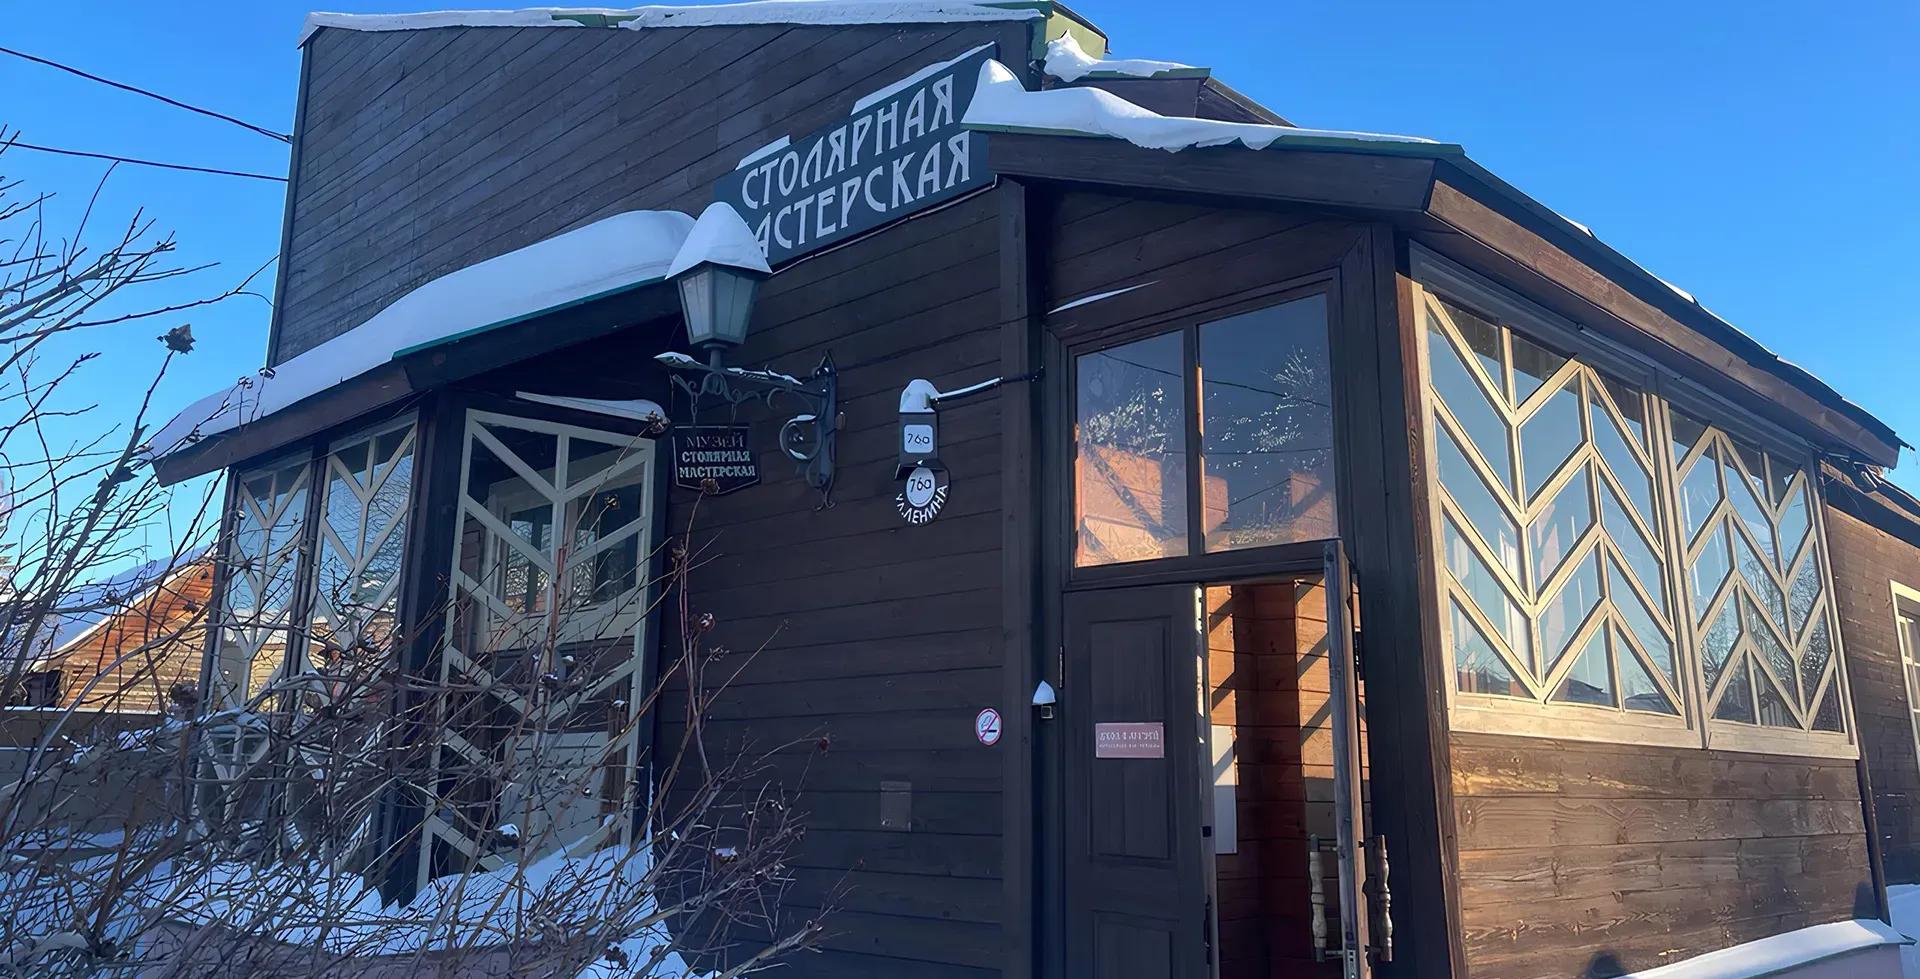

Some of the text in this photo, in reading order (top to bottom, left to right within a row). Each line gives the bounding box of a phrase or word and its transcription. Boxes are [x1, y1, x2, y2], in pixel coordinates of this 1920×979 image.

[741, 73, 954, 210] СТОЛЯРНАЯ
[747, 129, 971, 259] АСТЕРСКАЯ
[679, 465, 756, 478] МАСТЕРСКАЯ
